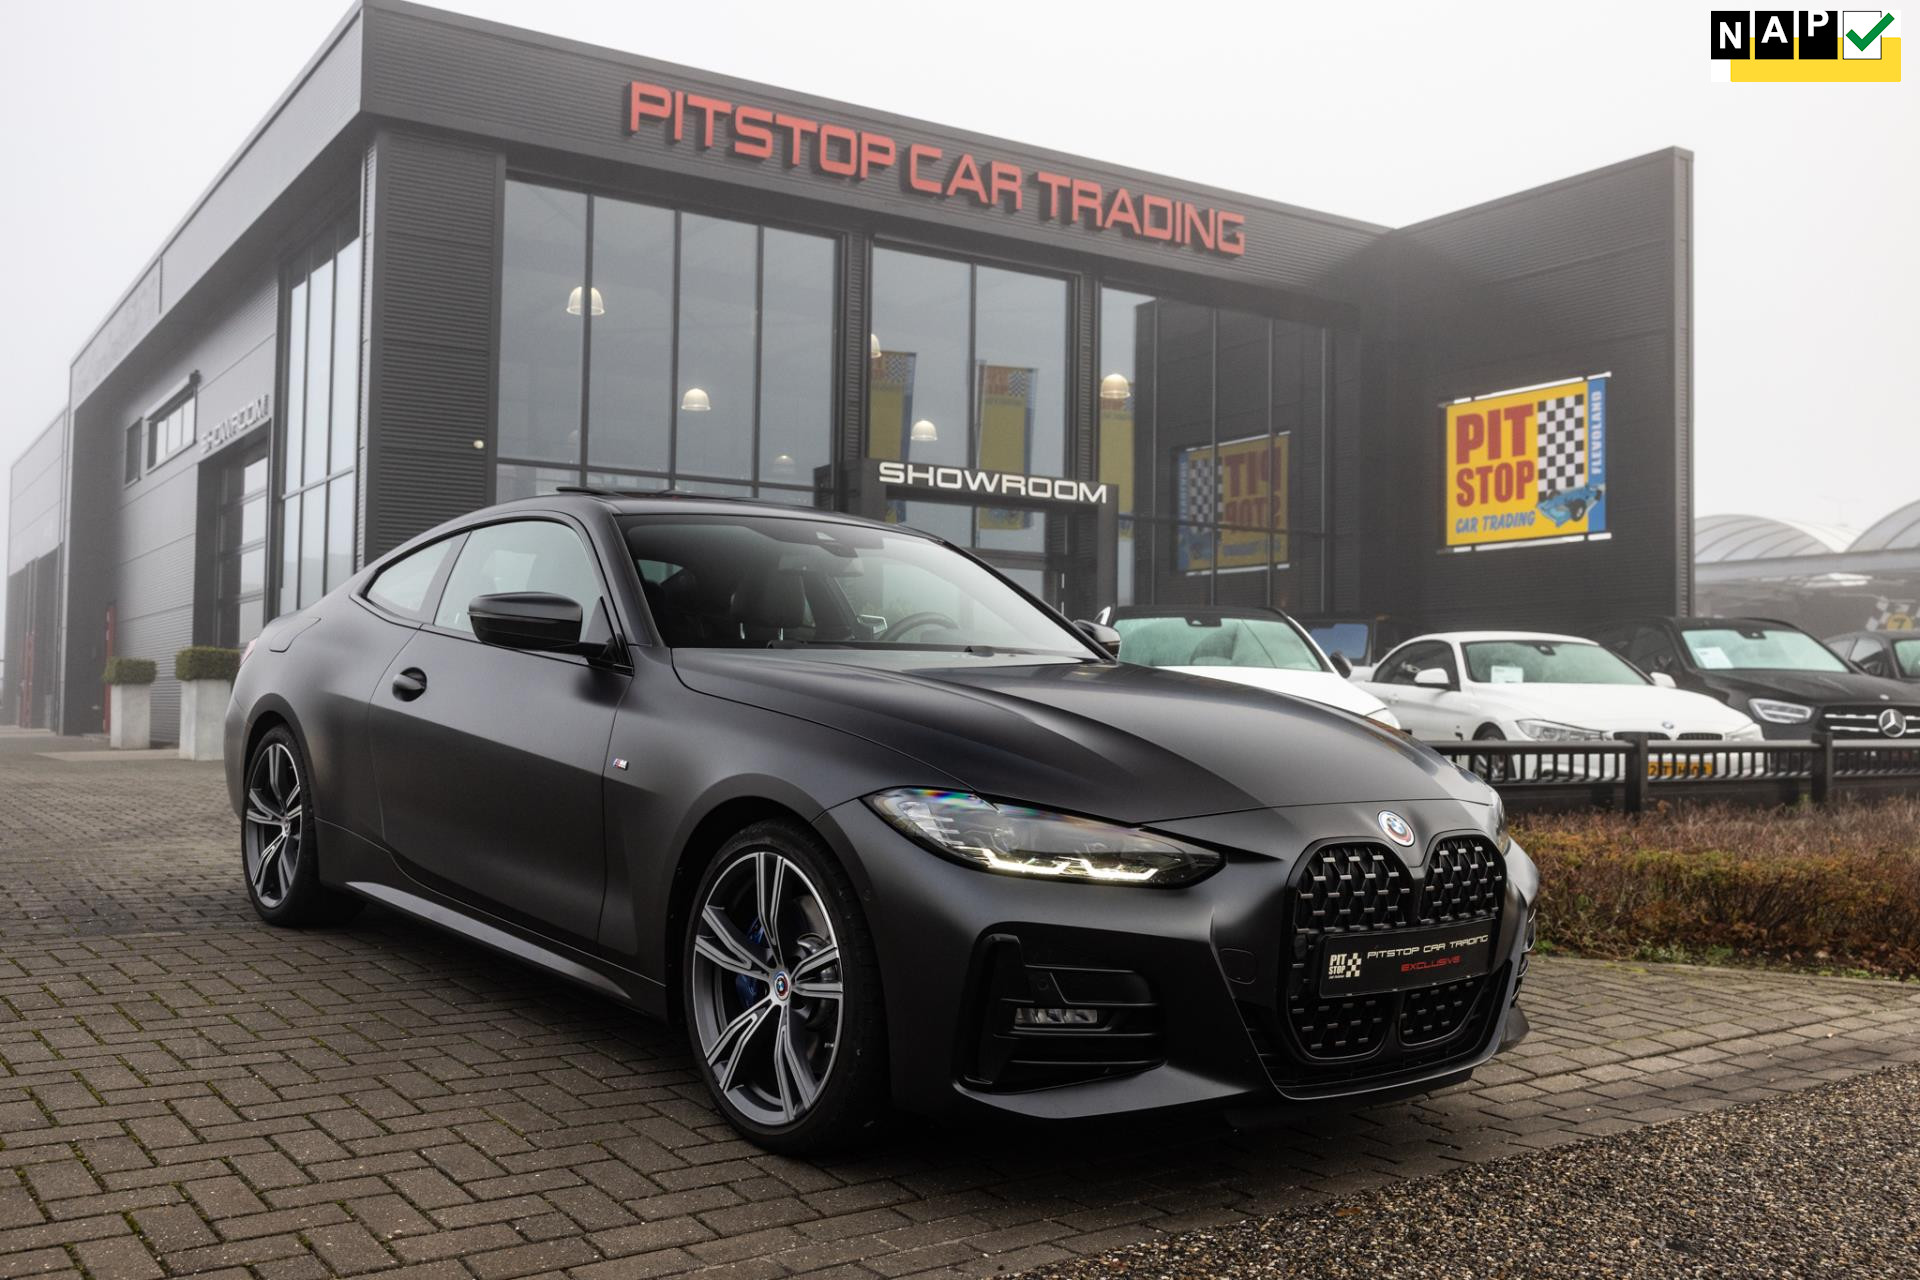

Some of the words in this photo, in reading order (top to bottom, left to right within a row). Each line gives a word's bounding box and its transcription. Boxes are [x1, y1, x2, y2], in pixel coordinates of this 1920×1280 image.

[627, 81, 896, 181] PITSTOP
[907, 142, 1023, 211] CAR
[1036, 170, 1246, 257] TRADING
[1456, 403, 1534, 465] PIT
[879, 461, 1107, 504] SHOWROOM
[1456, 460, 1535, 508] STOP
[1455, 517, 1478, 534] CAR
[1482, 510, 1536, 532] TRADING
[1367, 946, 1420, 959] PITSTOP
[1423, 943, 1446, 953] CAR
[1449, 934, 1488, 948] TRADING
[1328, 965, 1346, 976] STOP
[1330, 953, 1347, 966] PIT
[1401, 955, 1461, 972] EXCLUSIVE
